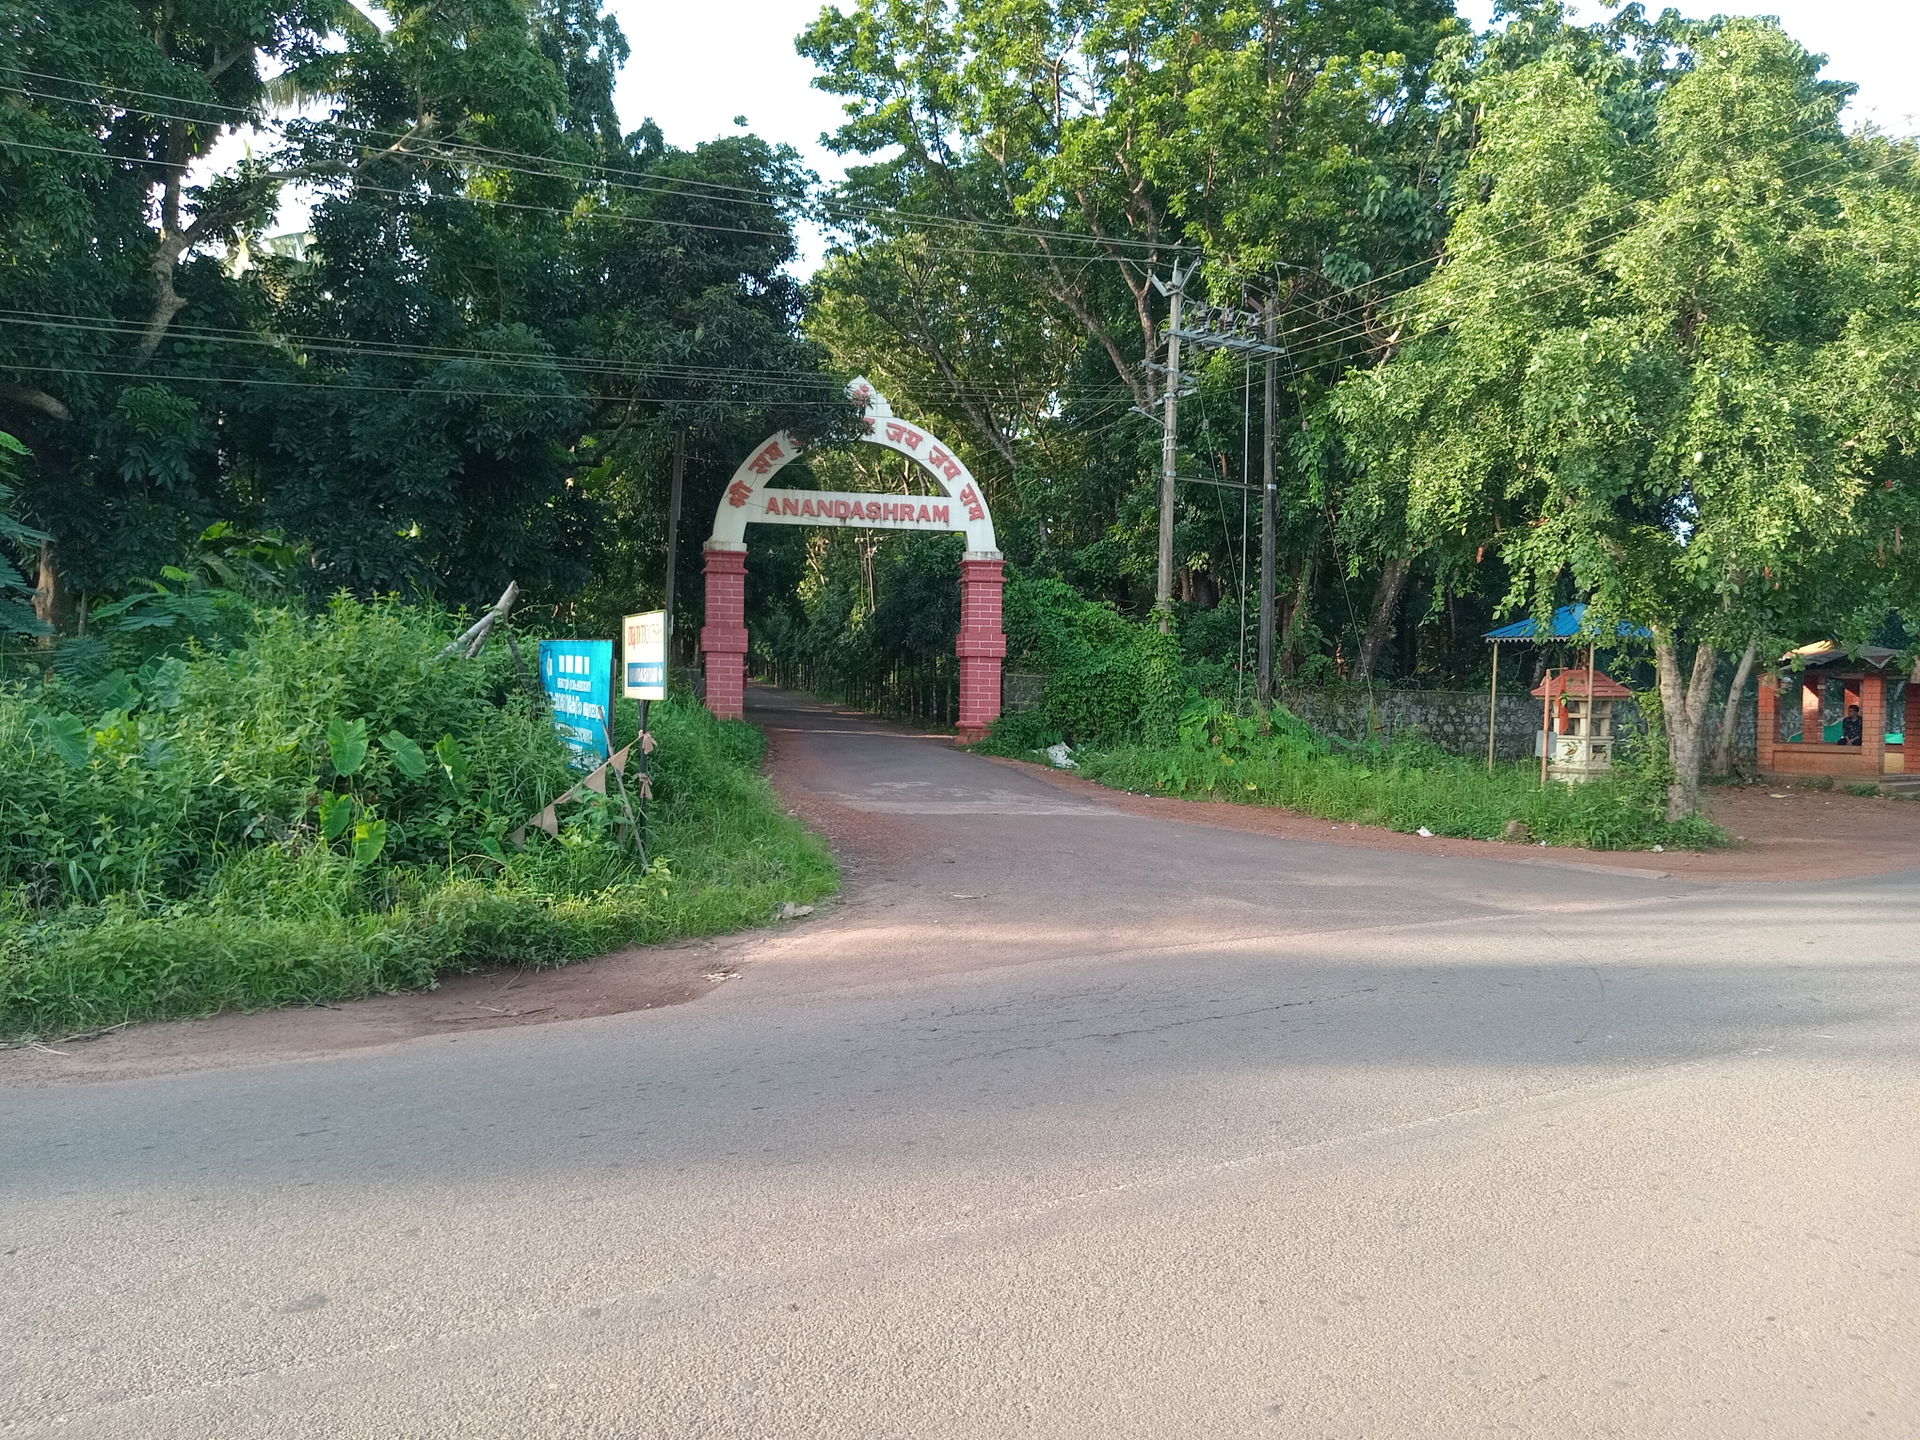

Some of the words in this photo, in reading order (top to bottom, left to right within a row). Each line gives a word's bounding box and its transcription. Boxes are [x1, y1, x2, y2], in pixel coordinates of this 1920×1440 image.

[748, 441, 785, 474] राम
[885, 421, 924, 451] जय
[928, 445, 962, 481] जय
[960, 482, 986, 521] राम
[765, 496, 950, 523] ANANDASHRAM
